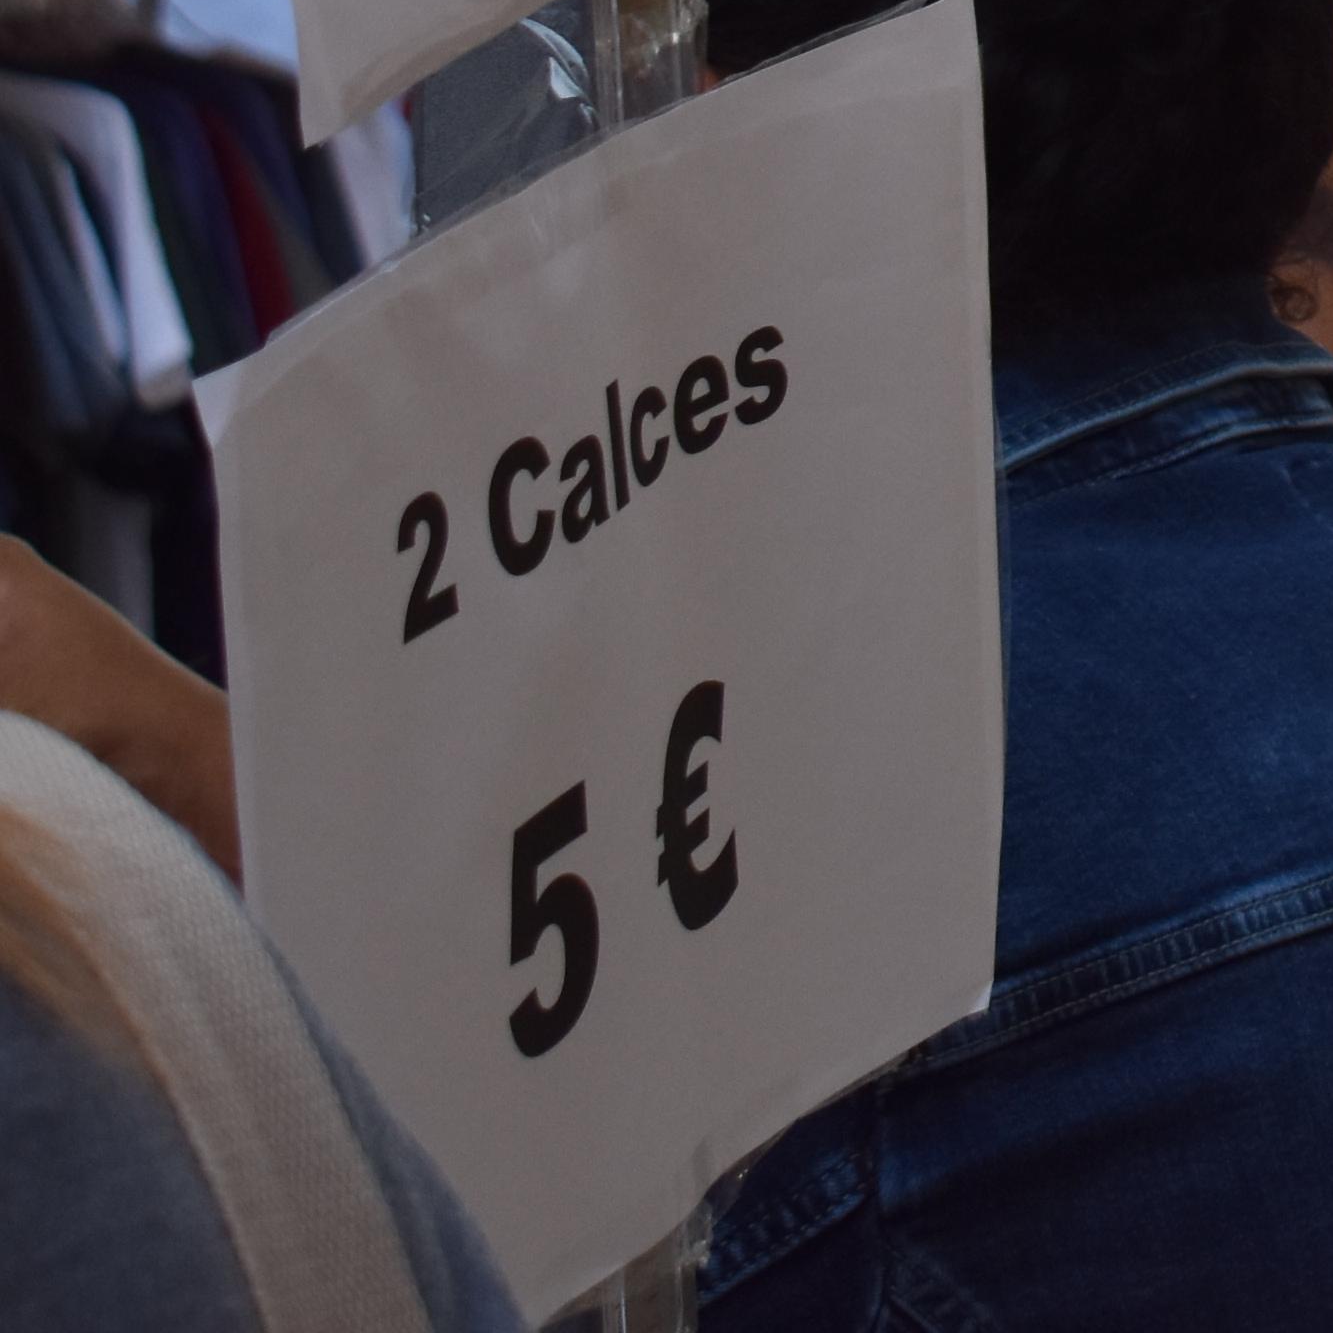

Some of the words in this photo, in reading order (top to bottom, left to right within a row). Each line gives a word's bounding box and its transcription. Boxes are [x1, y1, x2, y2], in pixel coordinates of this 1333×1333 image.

[395, 490, 460, 646] 2
[487, 325, 789, 577] Calces
[507, 779, 600, 1061] 5
[655, 679, 740, 932] €
